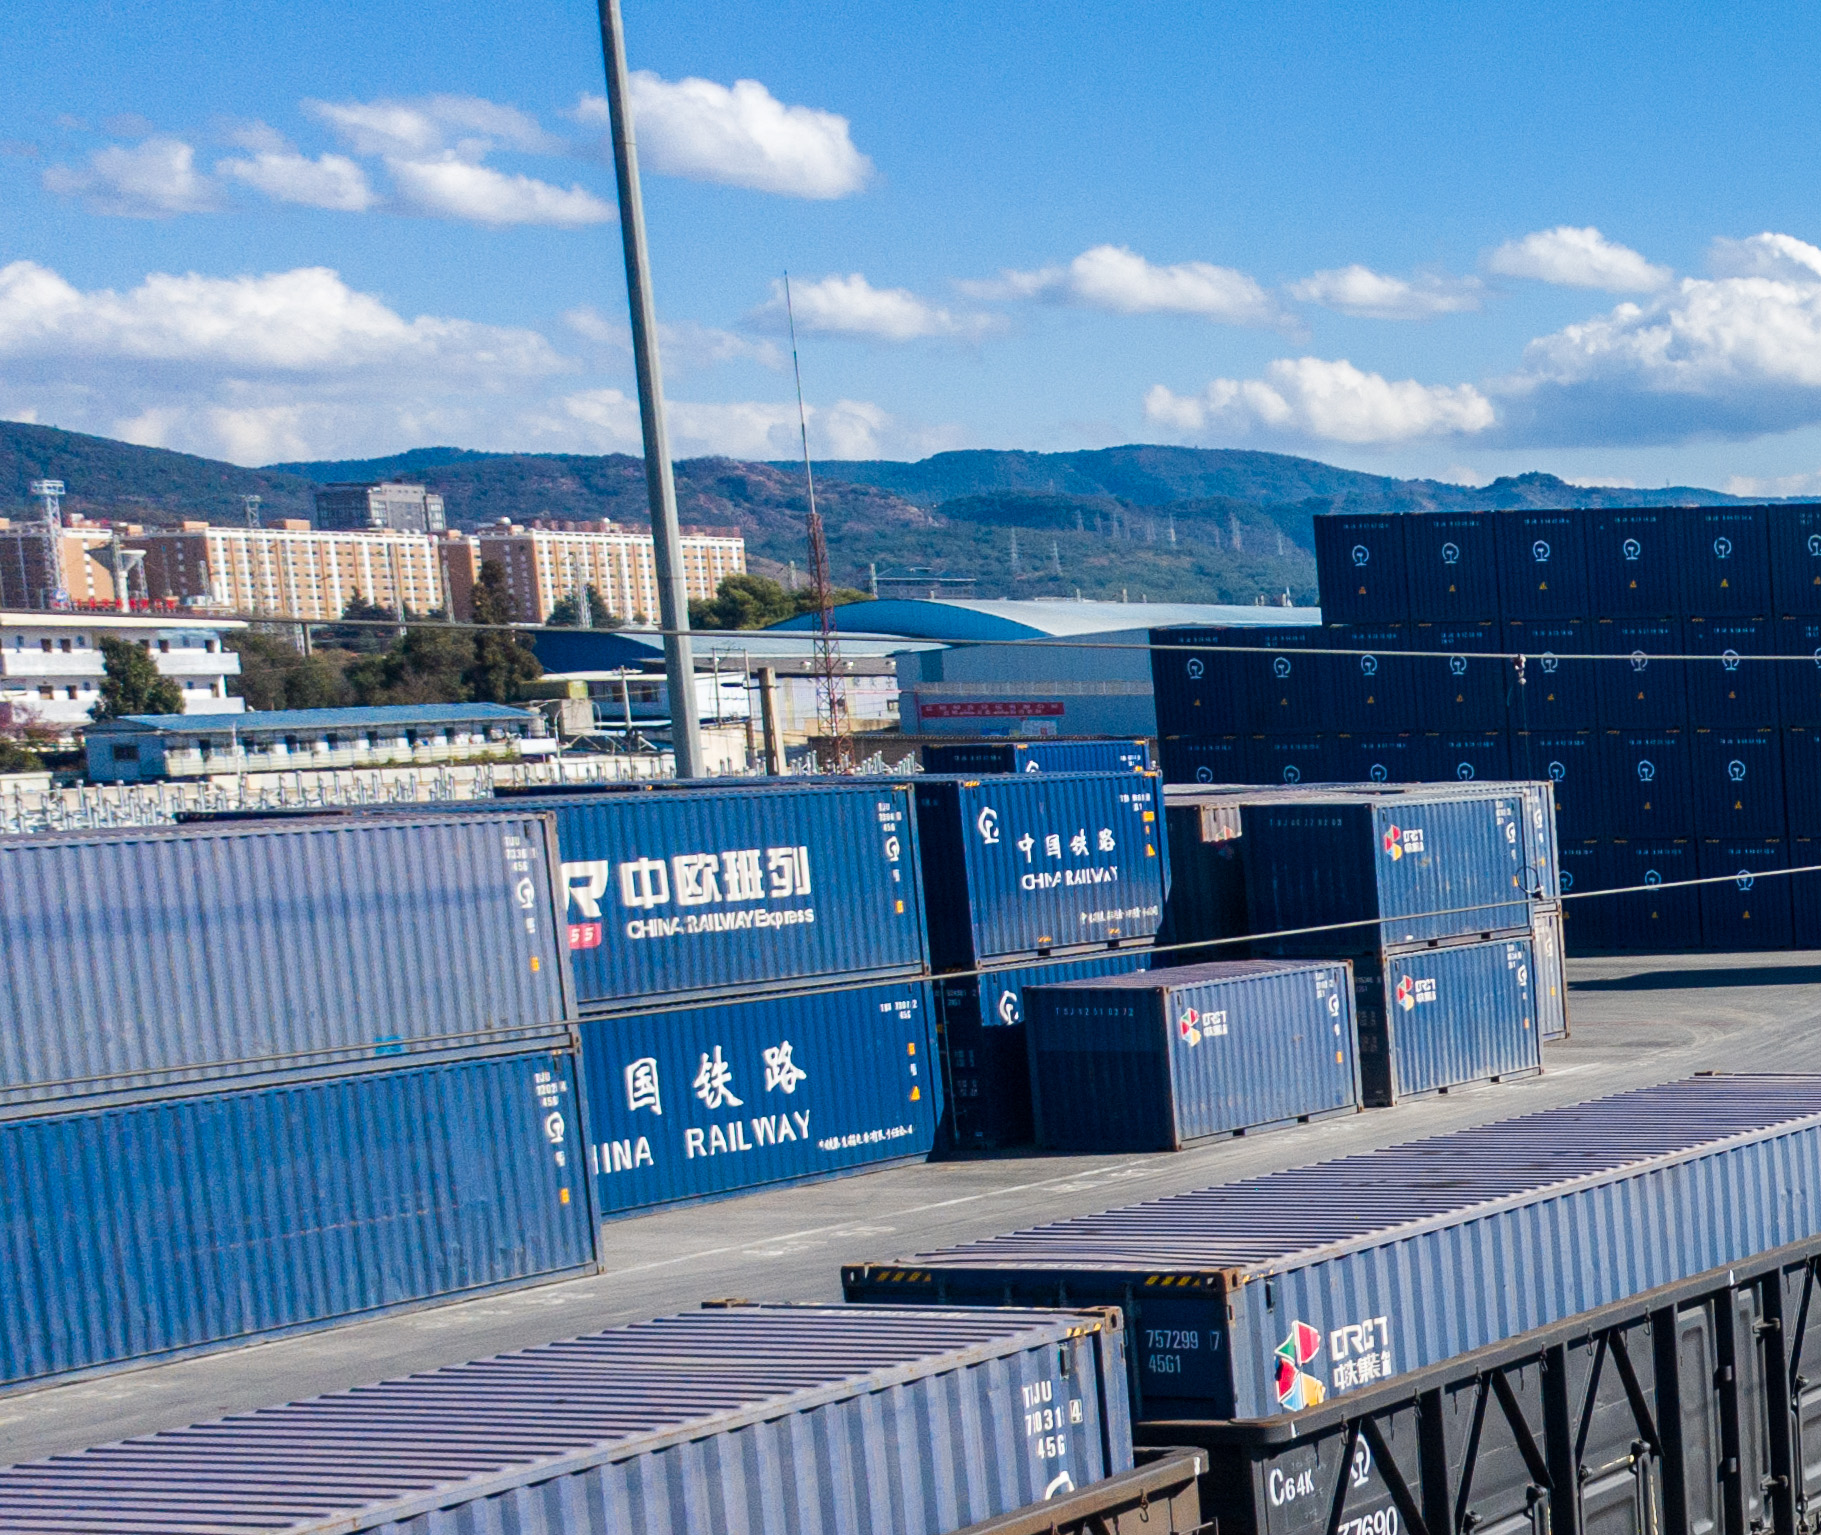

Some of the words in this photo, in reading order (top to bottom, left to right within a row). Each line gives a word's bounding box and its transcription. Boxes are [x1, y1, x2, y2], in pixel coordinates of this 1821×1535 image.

[1018, 828, 1115, 863] 中国铁路
[619, 846, 812, 909] 中欧班列
[625, 1040, 807, 1115] 国铁路
[593, 1136, 653, 1175] INA
[685, 1108, 811, 1159] RAILWAY
[1145, 1330, 1199, 1349] 757299
[1210, 1331, 1220, 1350] 7
[1330, 1316, 1389, 1362] CRCT
[1149, 1354, 1181, 1373] 45G1
[1269, 1467, 1315, 1507] C64K
